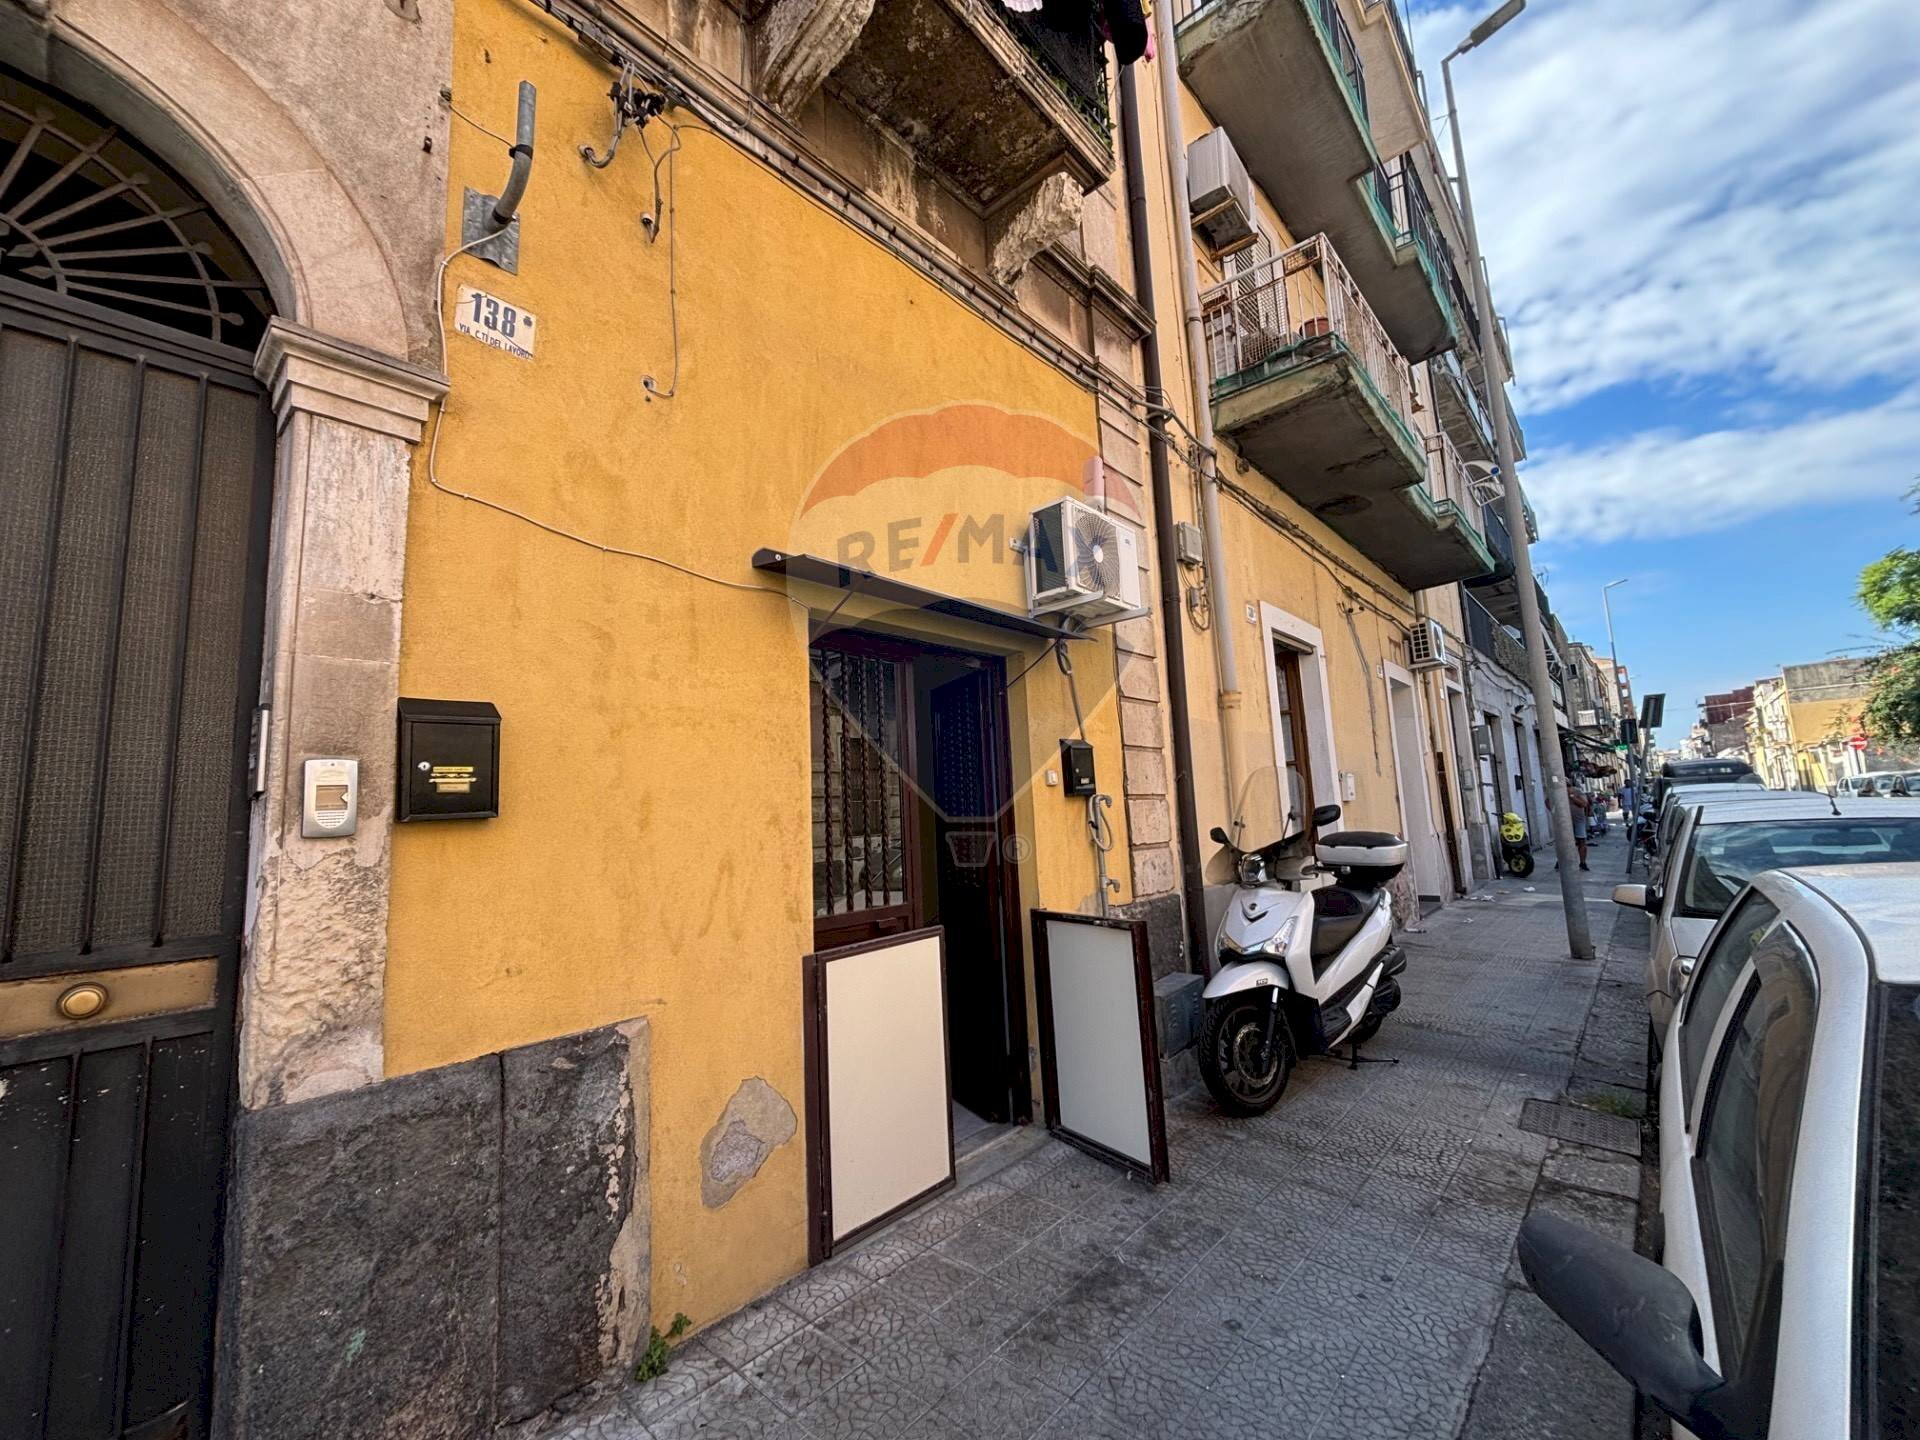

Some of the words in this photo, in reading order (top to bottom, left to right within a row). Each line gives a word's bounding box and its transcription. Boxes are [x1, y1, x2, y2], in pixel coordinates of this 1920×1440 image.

[472, 292, 517, 338] 138
[459, 323, 470, 335] VIA
[490, 336, 502, 349] DEL
